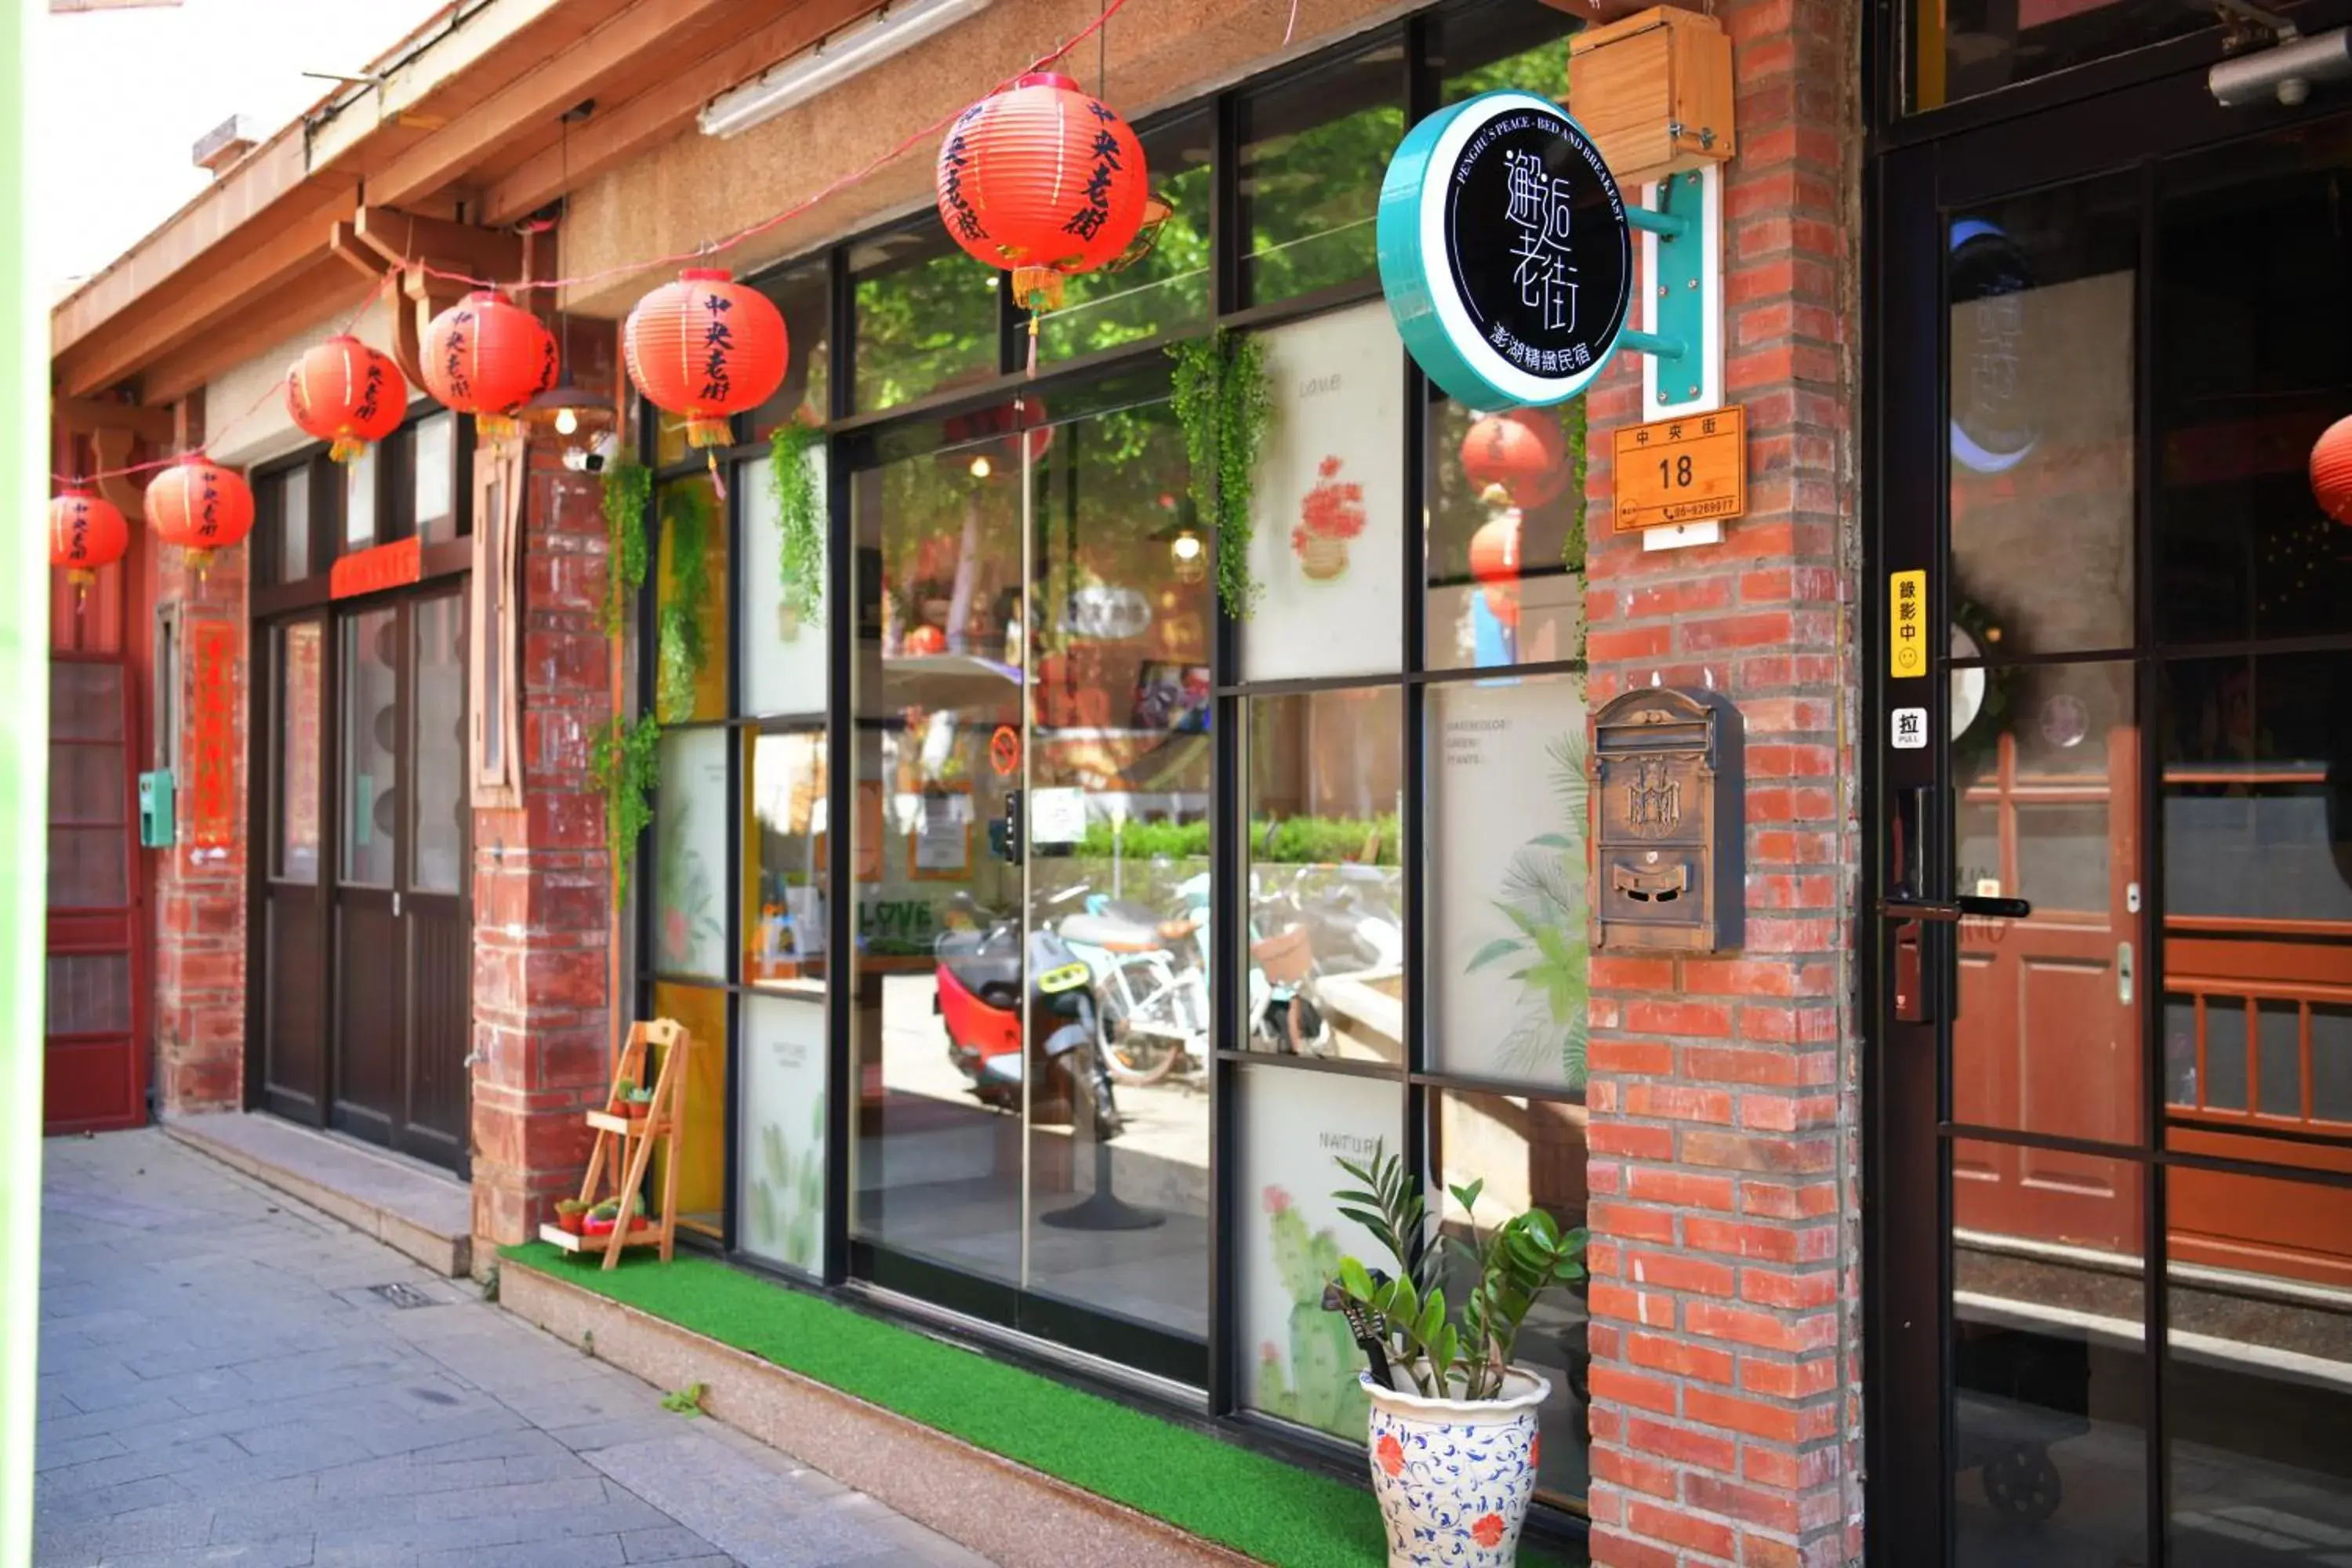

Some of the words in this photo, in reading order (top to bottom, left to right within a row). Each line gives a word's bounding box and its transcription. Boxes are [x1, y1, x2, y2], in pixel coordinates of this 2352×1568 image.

[1495, 115, 1530, 136] PEACE
[1537, 117, 1559, 134] BED
[1561, 128, 1583, 150] AND
[1583, 147, 1624, 222] BREAKFAST
[698, 294, 735, 402] 中央老街
[1490, 321, 1591, 372] 澎湖精緻民宿
[1636, 417, 1716, 445] 中央街
[1660, 455, 1693, 490] 18
[1900, 581, 1916, 641] 錄影中
[1898, 735, 1918, 744] PULL
[1899, 713, 1918, 735] 拉
[1319, 1131, 1381, 1156] NATUR
